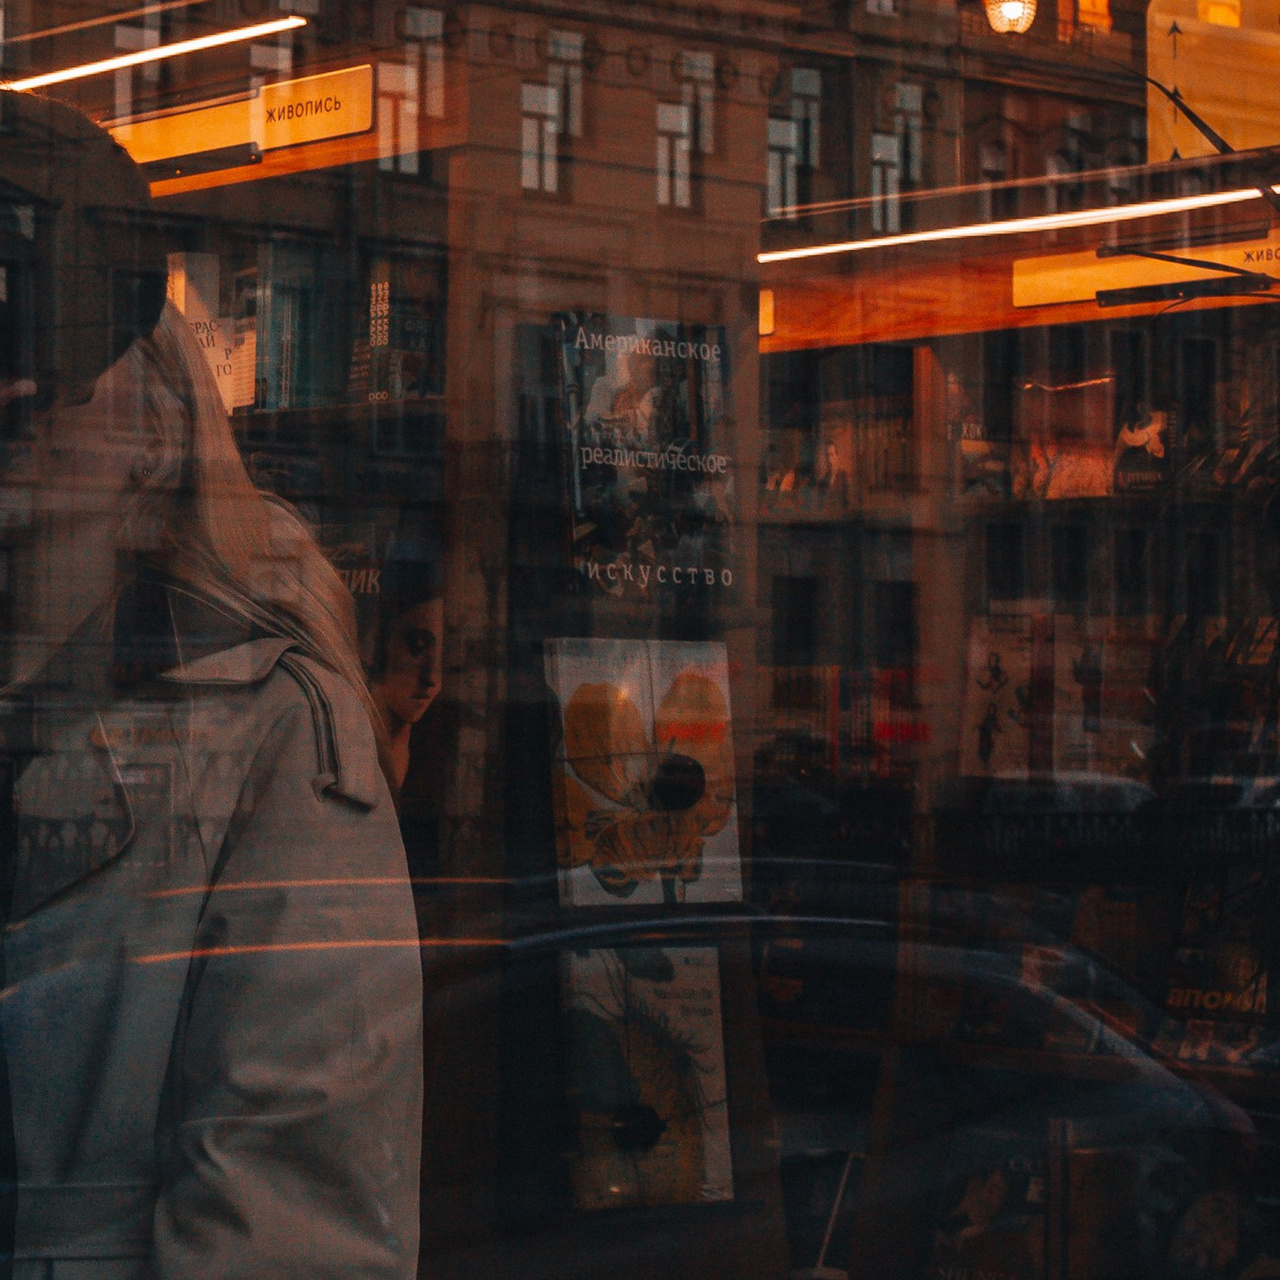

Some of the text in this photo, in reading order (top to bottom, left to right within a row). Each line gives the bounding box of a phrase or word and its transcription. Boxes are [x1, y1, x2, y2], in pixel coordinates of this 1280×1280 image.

[265, 96, 342, 123] ЖИВОПИСЬ
[575, 325, 721, 362] Американское
[581, 445, 728, 474] реалистическое
[587, 560, 734, 589] искусство
